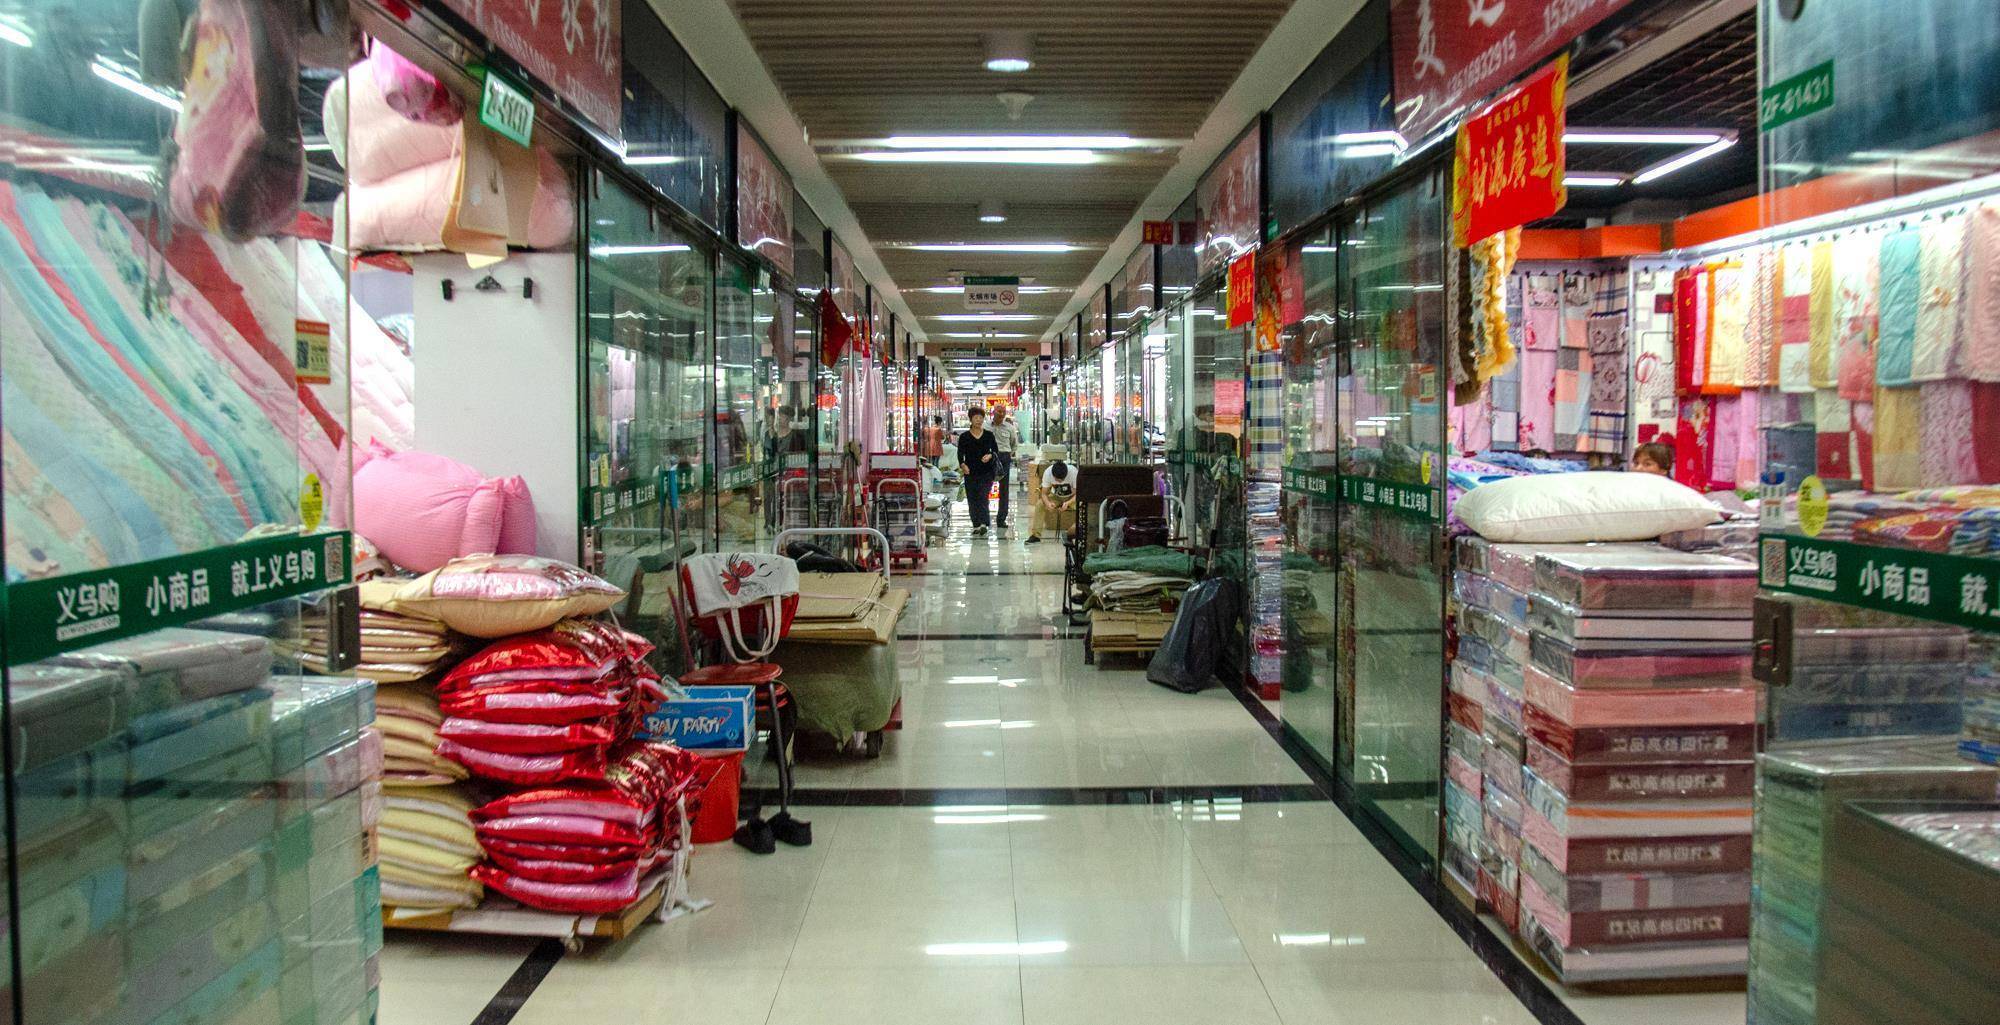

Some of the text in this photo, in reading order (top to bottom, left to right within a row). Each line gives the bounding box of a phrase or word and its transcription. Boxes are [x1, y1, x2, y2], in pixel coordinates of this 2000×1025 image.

[56, 547, 317, 624] 义乌购 小商品 就上义乌购
[1788, 545, 1838, 578] 义乌购
[1858, 559, 1931, 606] 小商品
